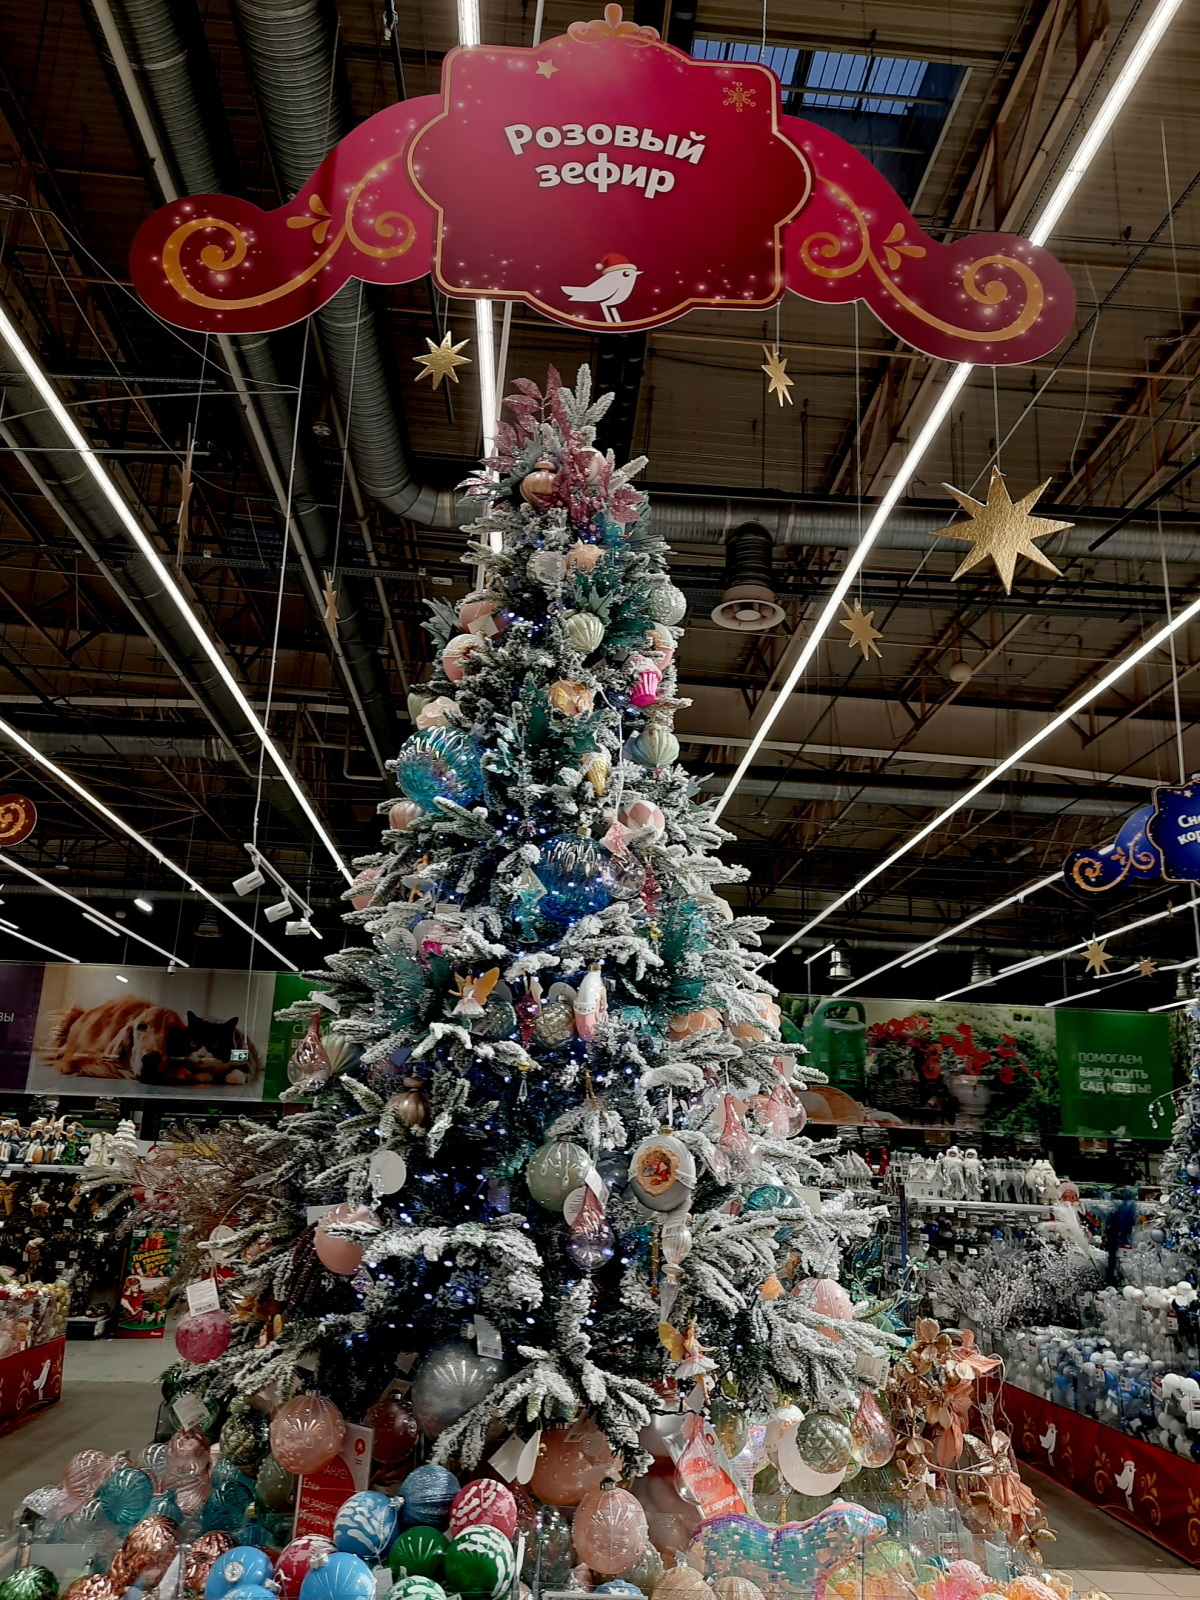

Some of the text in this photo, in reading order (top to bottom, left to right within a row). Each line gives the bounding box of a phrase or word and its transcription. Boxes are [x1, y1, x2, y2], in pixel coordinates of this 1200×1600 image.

[504, 123, 706, 165] Розовый
[535, 153, 676, 199] зефир
[1078, 1052, 1143, 1065] ПОМОГАЕМ
[1079, 1066, 1149, 1080] ВЫРАСТИТЬ
[1079, 1081, 1106, 1094] САД
[132, 1248, 173, 1262] Праздник
